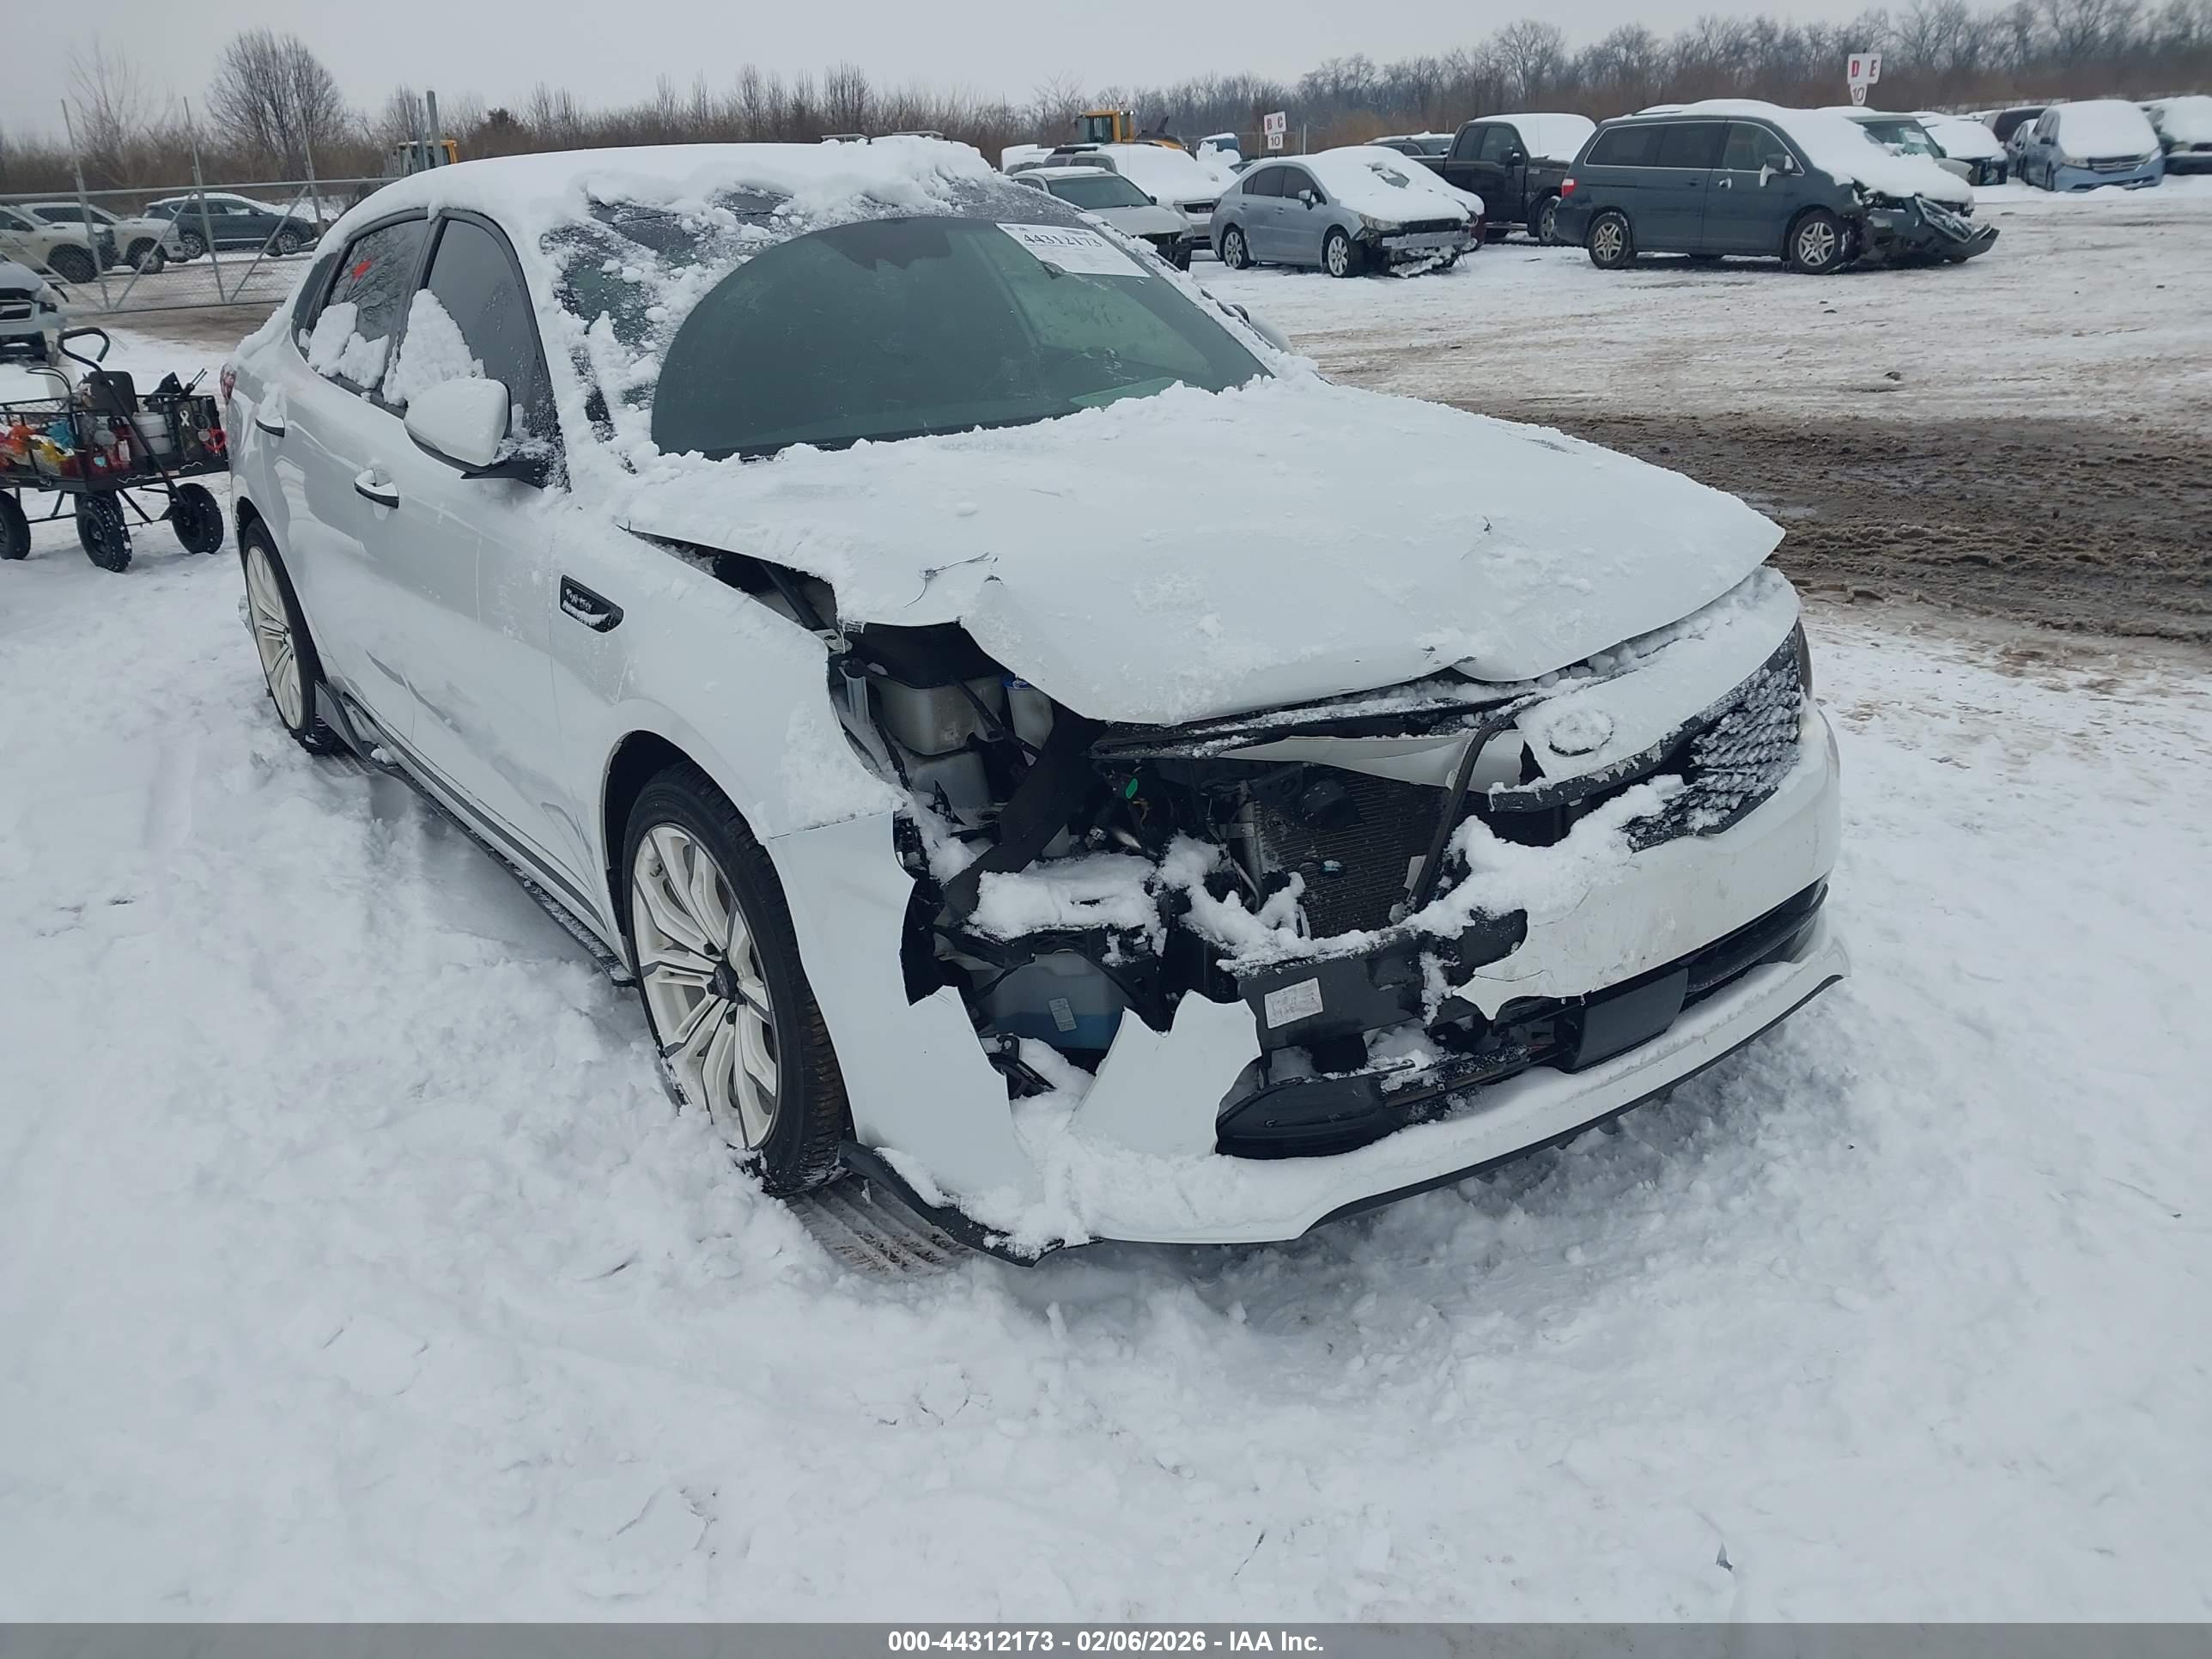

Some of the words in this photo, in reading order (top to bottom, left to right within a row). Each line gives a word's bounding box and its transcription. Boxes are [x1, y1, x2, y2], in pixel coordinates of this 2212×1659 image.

[1851, 59, 1860, 77] D
[1869, 59, 1877, 77] E
[1852, 87, 1865, 102] 10
[1277, 115, 1284, 129] C
[1270, 136, 1280, 147] 10
[1024, 234, 1103, 248] 44312173
